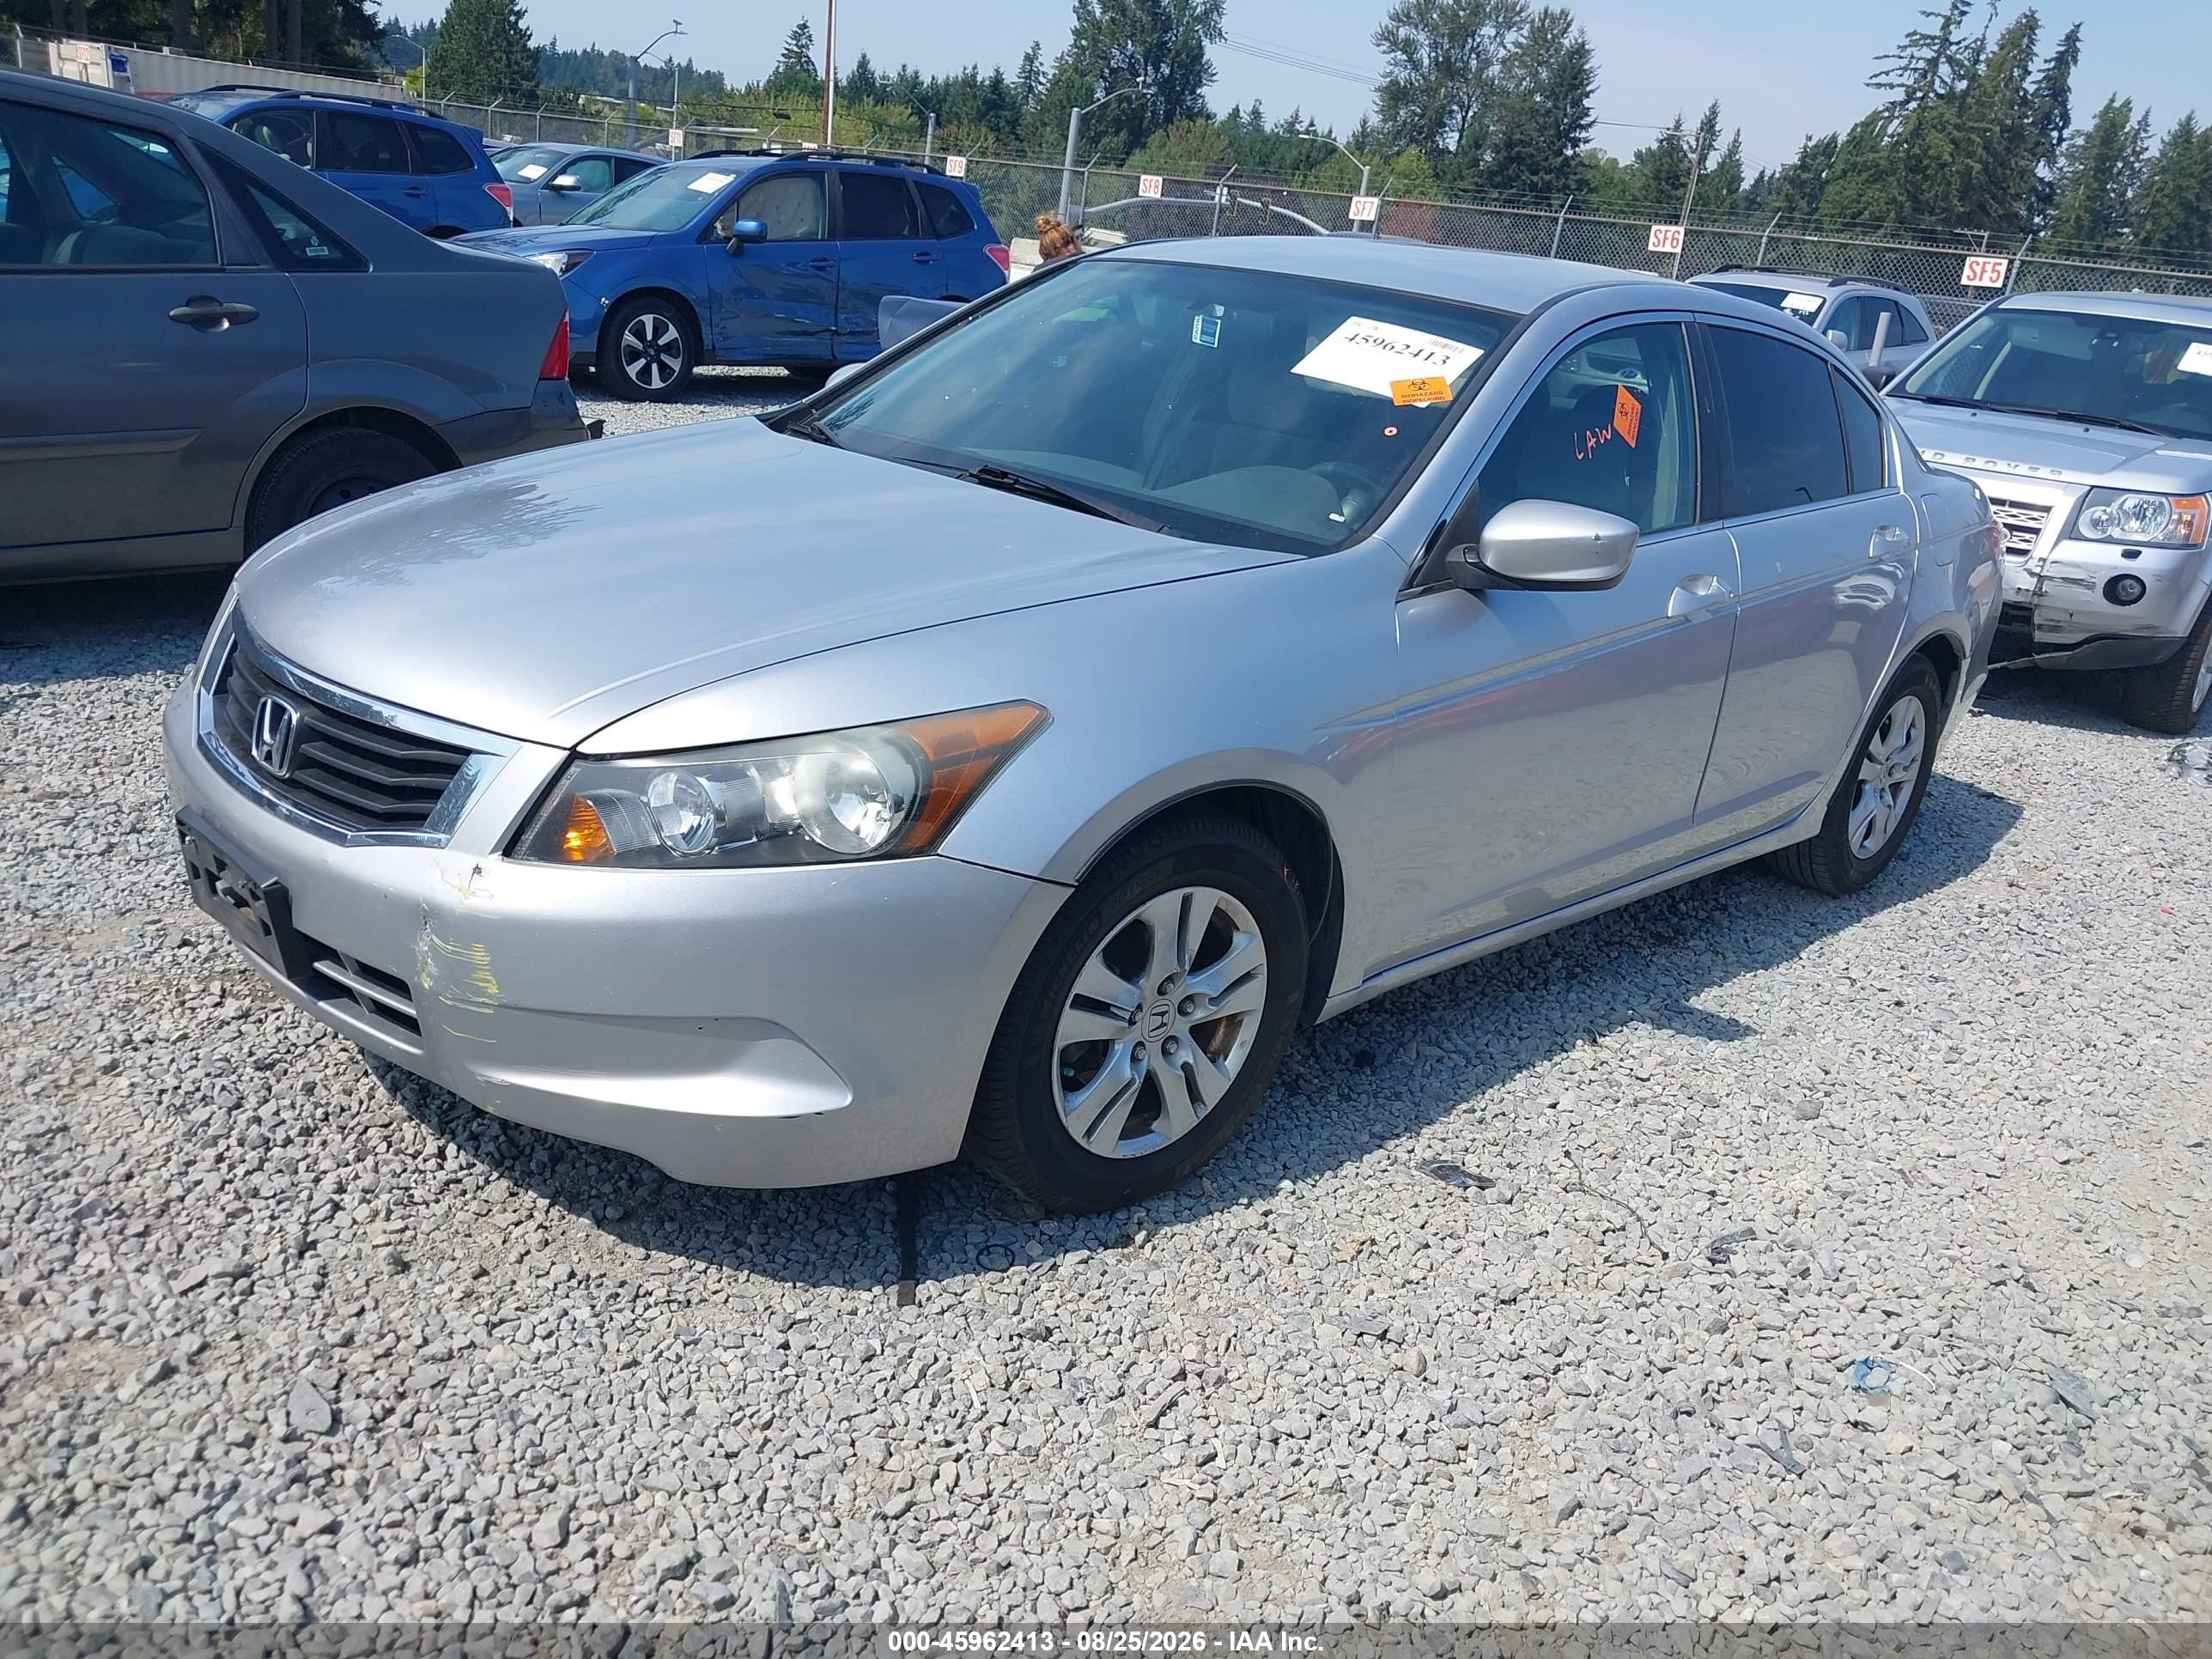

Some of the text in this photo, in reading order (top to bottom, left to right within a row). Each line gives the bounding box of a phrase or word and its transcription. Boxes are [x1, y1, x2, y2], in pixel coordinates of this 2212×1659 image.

[948, 159, 963, 173] SF9
[1142, 178, 1160, 195] SF8
[1353, 200, 1375, 217] SF7
[1652, 228, 1681, 249] SF6
[1966, 260, 2003, 283] SF5
[1344, 332, 1451, 366] 45962413
[1401, 390, 1443, 398] BIOHAZARD
[1574, 423, 1612, 460] LAW
[1964, 456, 2063, 476] ROVER
